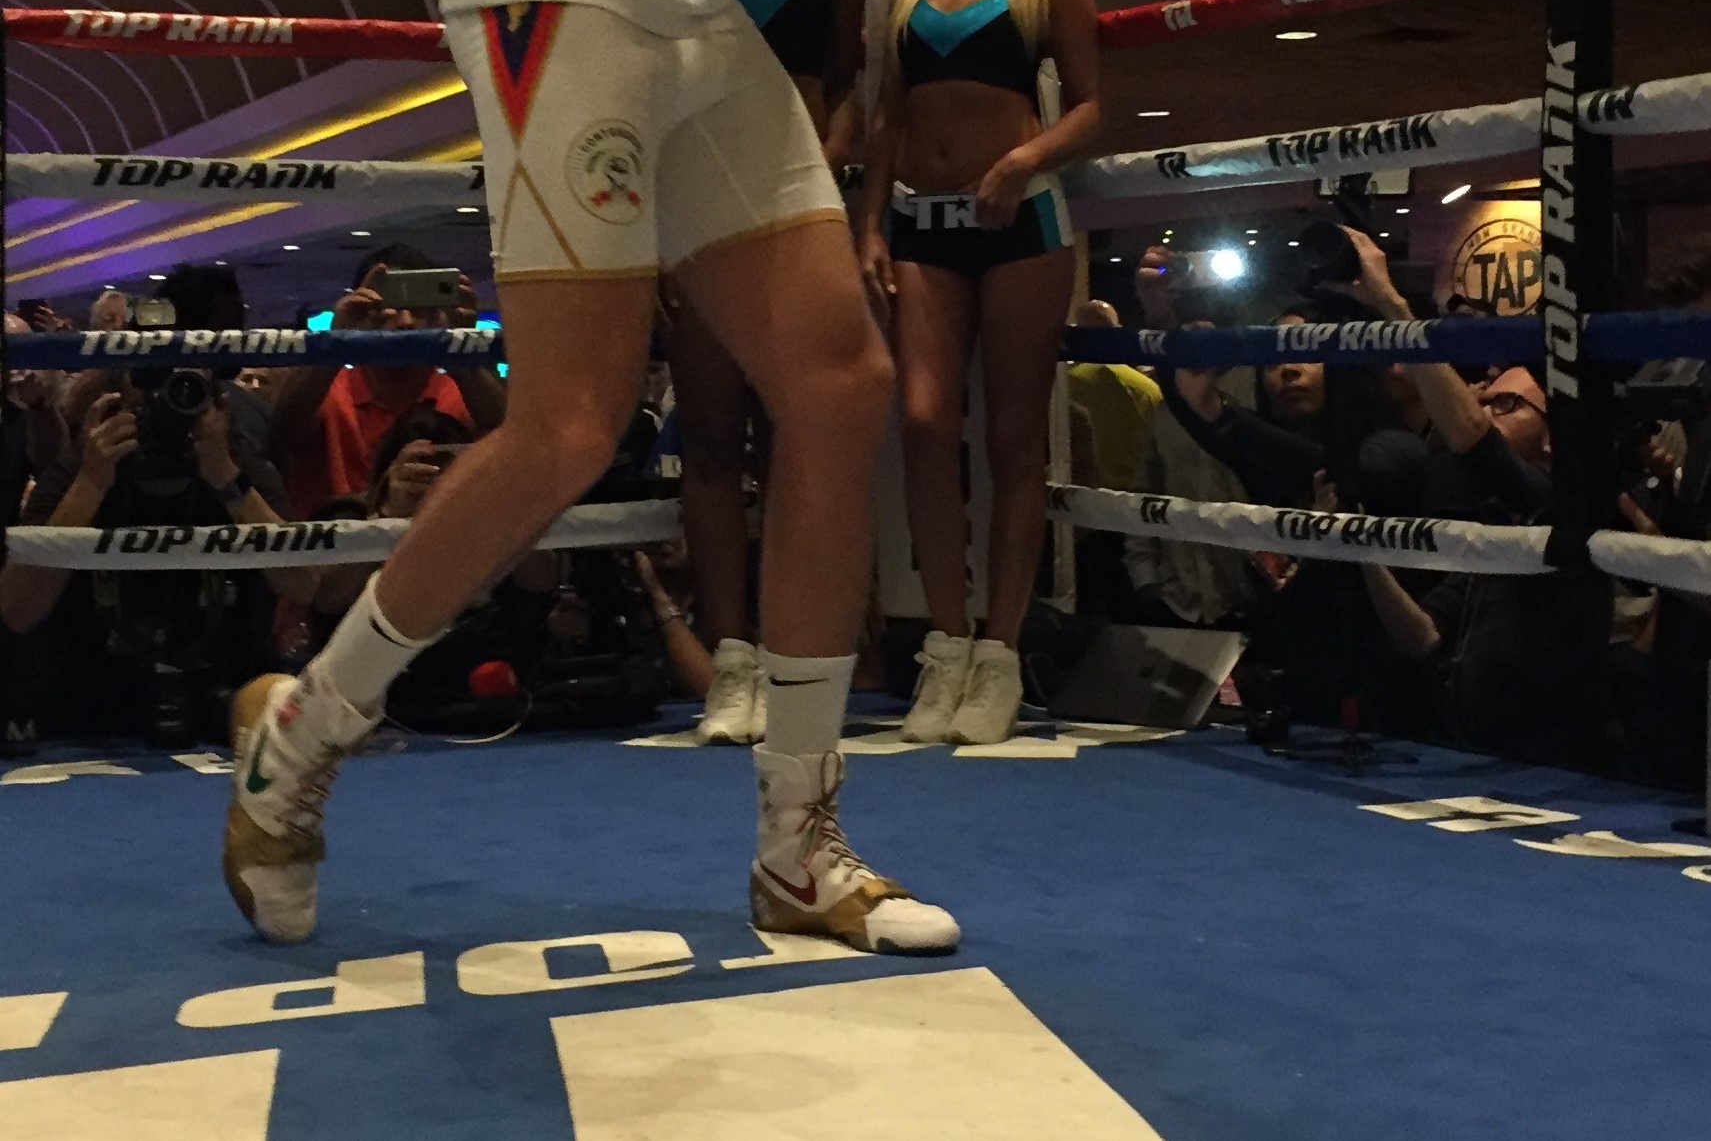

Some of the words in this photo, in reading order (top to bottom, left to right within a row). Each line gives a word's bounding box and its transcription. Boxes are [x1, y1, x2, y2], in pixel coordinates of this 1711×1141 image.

[63, 9, 161, 39] TOP
[167, 14, 298, 44] RANK
[1267, 130, 1331, 168] TOP
[1339, 115, 1438, 160] RANK
[1543, 28, 1577, 244] RANK
[92, 157, 194, 188] TOP
[200, 161, 339, 190] RANK
[1473, 248, 1542, 309] TAP
[80, 330, 174, 356] TOP
[180, 328, 307, 354] RANK
[1277, 323, 1339, 353] TOP
[1339, 319, 1438, 351] RANK
[1543, 254, 1579, 399] TOP
[94, 525, 195, 554] TOP
[202, 522, 339, 554] RANK
[1276, 510, 1340, 541] TOP
[1340, 516, 1440, 552] RANK
